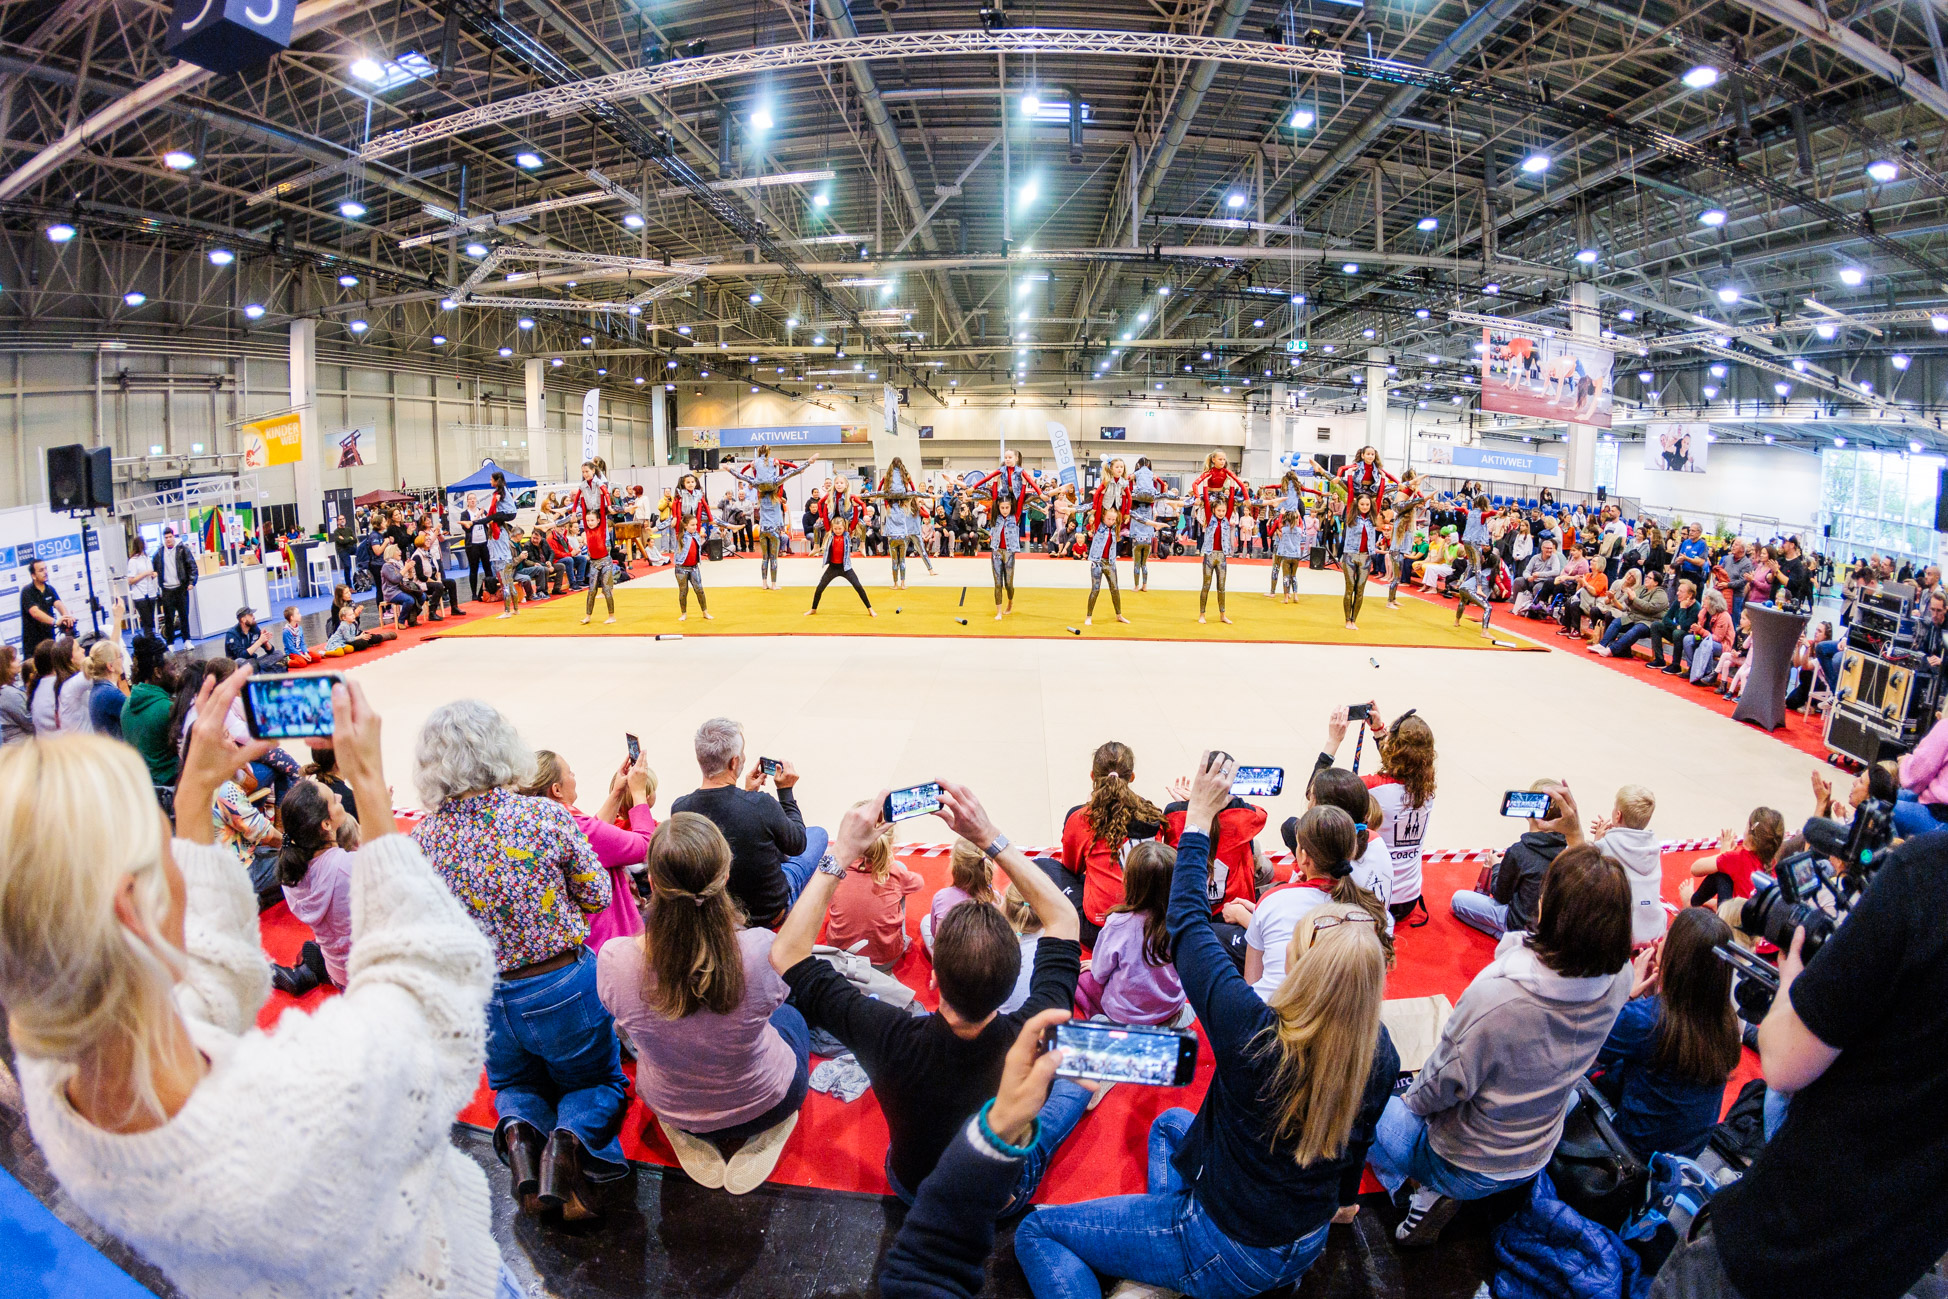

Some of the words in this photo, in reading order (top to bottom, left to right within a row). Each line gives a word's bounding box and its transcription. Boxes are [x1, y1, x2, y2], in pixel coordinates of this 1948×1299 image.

[265, 422, 299, 440] KINDER
[585, 404, 596, 460] espo
[750, 430, 809, 442] AKTIVWELT
[281, 434, 299, 446] WELT
[1481, 454, 1533, 469] AKTIVWELT
[157, 481, 168, 490] FG
[37, 538, 72, 557] espo
[1390, 848, 1419, 860] Coach
